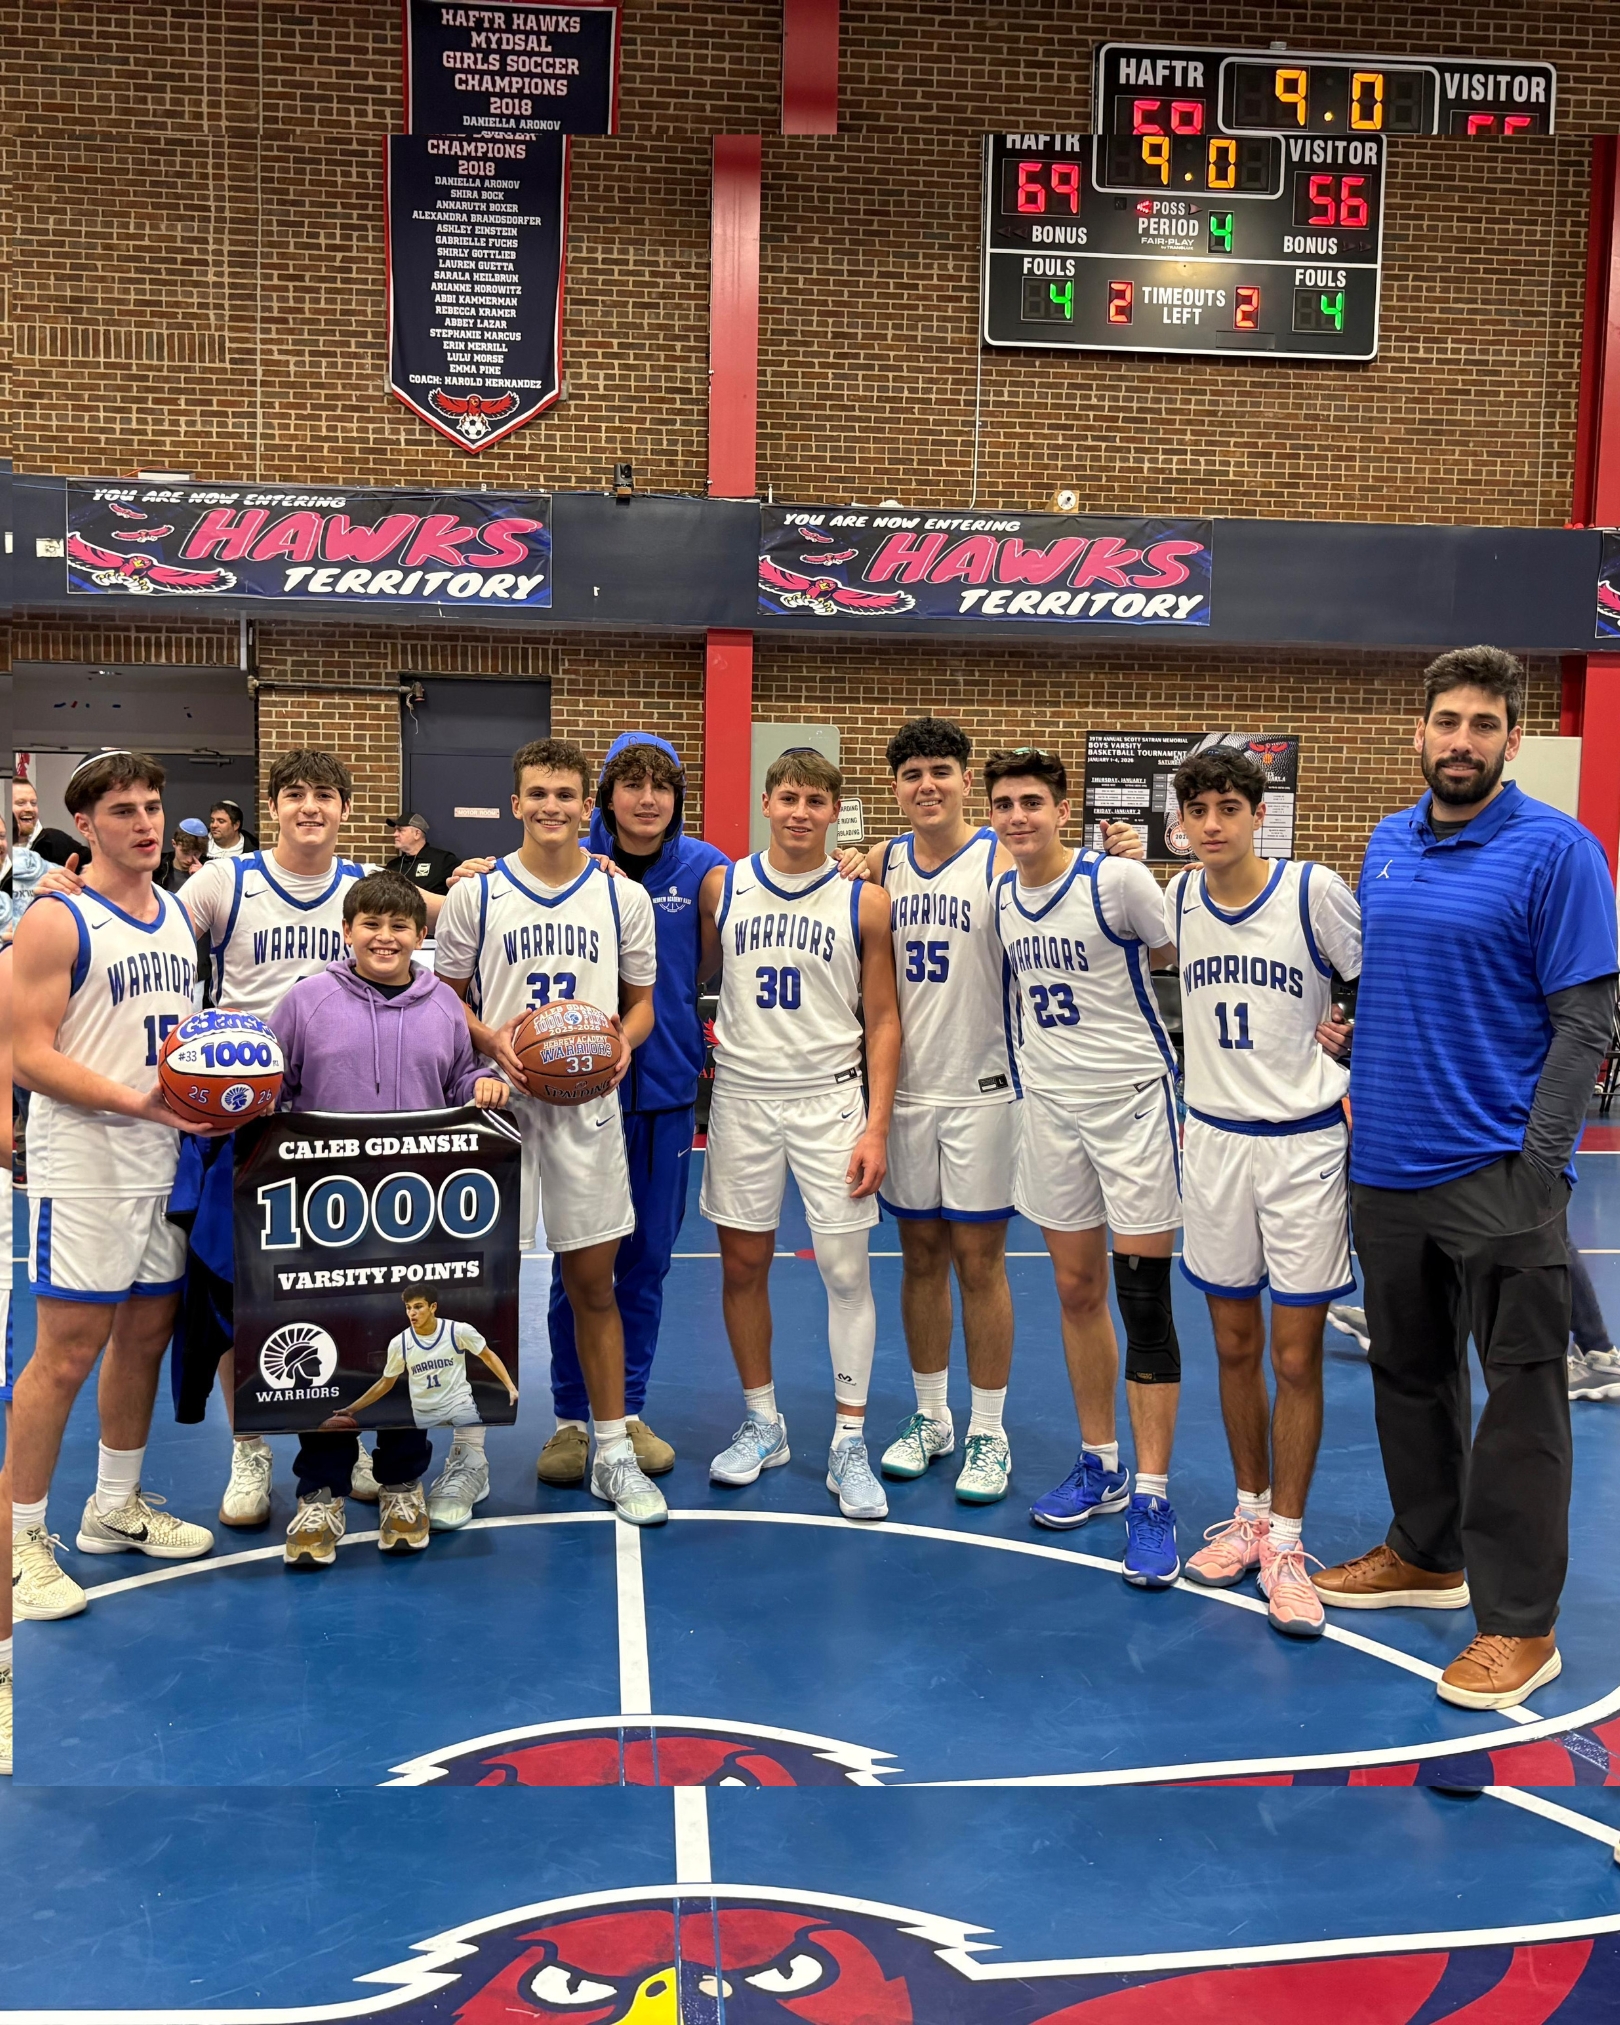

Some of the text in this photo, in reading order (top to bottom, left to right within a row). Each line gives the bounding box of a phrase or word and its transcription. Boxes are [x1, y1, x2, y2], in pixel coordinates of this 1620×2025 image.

[441, 9, 580, 33] HAFTR HAWKS
[471, 31, 552, 53] MYDSAL
[442, 51, 579, 75] GIRLS SOCCER
[1119, 57, 1204, 88] HAFTR
[454, 74, 568, 96] CHAMPIONS
[1444, 72, 1546, 103] VISITOR
[489, 98, 532, 116] 2018
[463, 115, 561, 131] DANIELLA ARONOV
[427, 139, 526, 159] CHAMPIONS
[1289, 139, 1377, 165] VISITOR
[458, 160, 495, 176] 2018
[434, 176, 520, 190] DANIELLA ARONOV
[1017, 162, 1079, 214] 69
[450, 189, 504, 200] SHIRA BOCK
[1308, 175, 1368, 227] 56
[436, 200, 519, 213] ANNARUTH BOXER
[1153, 201, 1186, 216] POSS
[412, 210, 541, 226] ALEXANDRA BRANDSDORFER
[1138, 217, 1199, 236] PERIOD
[436, 224, 518, 237] ASHLEY EINSTEIN
[1032, 225, 1088, 245] BONUS
[1210, 213, 1232, 252] 4
[435, 235, 519, 248] GABRIELLE FUCHS
[1283, 235, 1338, 255] BONUS
[437, 248, 517, 260] SHIRLY GOTTLIEB
[438, 259, 514, 271] LAUREN GUETTA
[1023, 257, 1076, 277] FOULS
[434, 271, 519, 283] SARALA HEILBRUN
[1295, 268, 1347, 287] FOULS
[431, 282, 522, 295] ARIANNE HOROWITZ
[1141, 286, 1226, 307] TIMEOUTS
[435, 294, 518, 306] ABBI KAMMERMAN
[1049, 280, 1072, 320] 4
[1109, 282, 1132, 323] 2
[1235, 288, 1259, 328] 2
[435, 306, 517, 317] REBECCA KRAMER
[1162, 307, 1203, 324] LEFT
[1320, 292, 1343, 331] 4
[444, 317, 507, 329] ABBEY LAZAR
[430, 329, 521, 341] STEPHANIE MARCUS
[443, 341, 508, 352] ERIN MERRILL
[447, 352, 504, 363] LULU MORSE
[450, 364, 501, 375] EMMA PINE
[409, 375, 542, 389] COACH: HAROLD HERNANDEZ
[93, 489, 347, 508] YOU ARE NOW ENTERING
[783, 514, 1020, 533] YOU ARE NOW ENTERING
[179, 508, 544, 568] HAWKS
[862, 533, 1204, 589] HAWKS
[284, 567, 544, 601] TERRITORY
[958, 589, 1203, 619] TERRITORY
[890, 893, 970, 933] WARRIORS
[503, 922, 599, 966] WARRIORS
[735, 913, 836, 962] WARRIORS
[905, 940, 949, 983] 35
[1008, 935, 1089, 975] WARRIORS
[1183, 954, 1303, 999] WARRIORS
[526, 972, 576, 1012] 33
[755, 966, 801, 1010] 30
[1029, 983, 1081, 1028] 23
[549, 1024, 600, 1036] 2025-2026
[1214, 1002, 1254, 1049] 11
[543, 1035, 608, 1049] HEBREW ACADEMY
[178, 1041, 272, 1068] #33 1000
[540, 1043, 612, 1064] WARRIORS
[566, 1056, 593, 1073] 33
[189, 1085, 210, 1104] 25
[257, 1089, 272, 1105] 26
[278, 1133, 479, 1160] CALEB GDANSKI
[257, 1168, 500, 1250] 1000
[278, 1260, 480, 1290] VARSITY POINTS
[411, 1358, 454, 1375] WARRIORS
[426, 1374, 442, 1389] 11
[256, 1386, 340, 1403] WARRIORS
